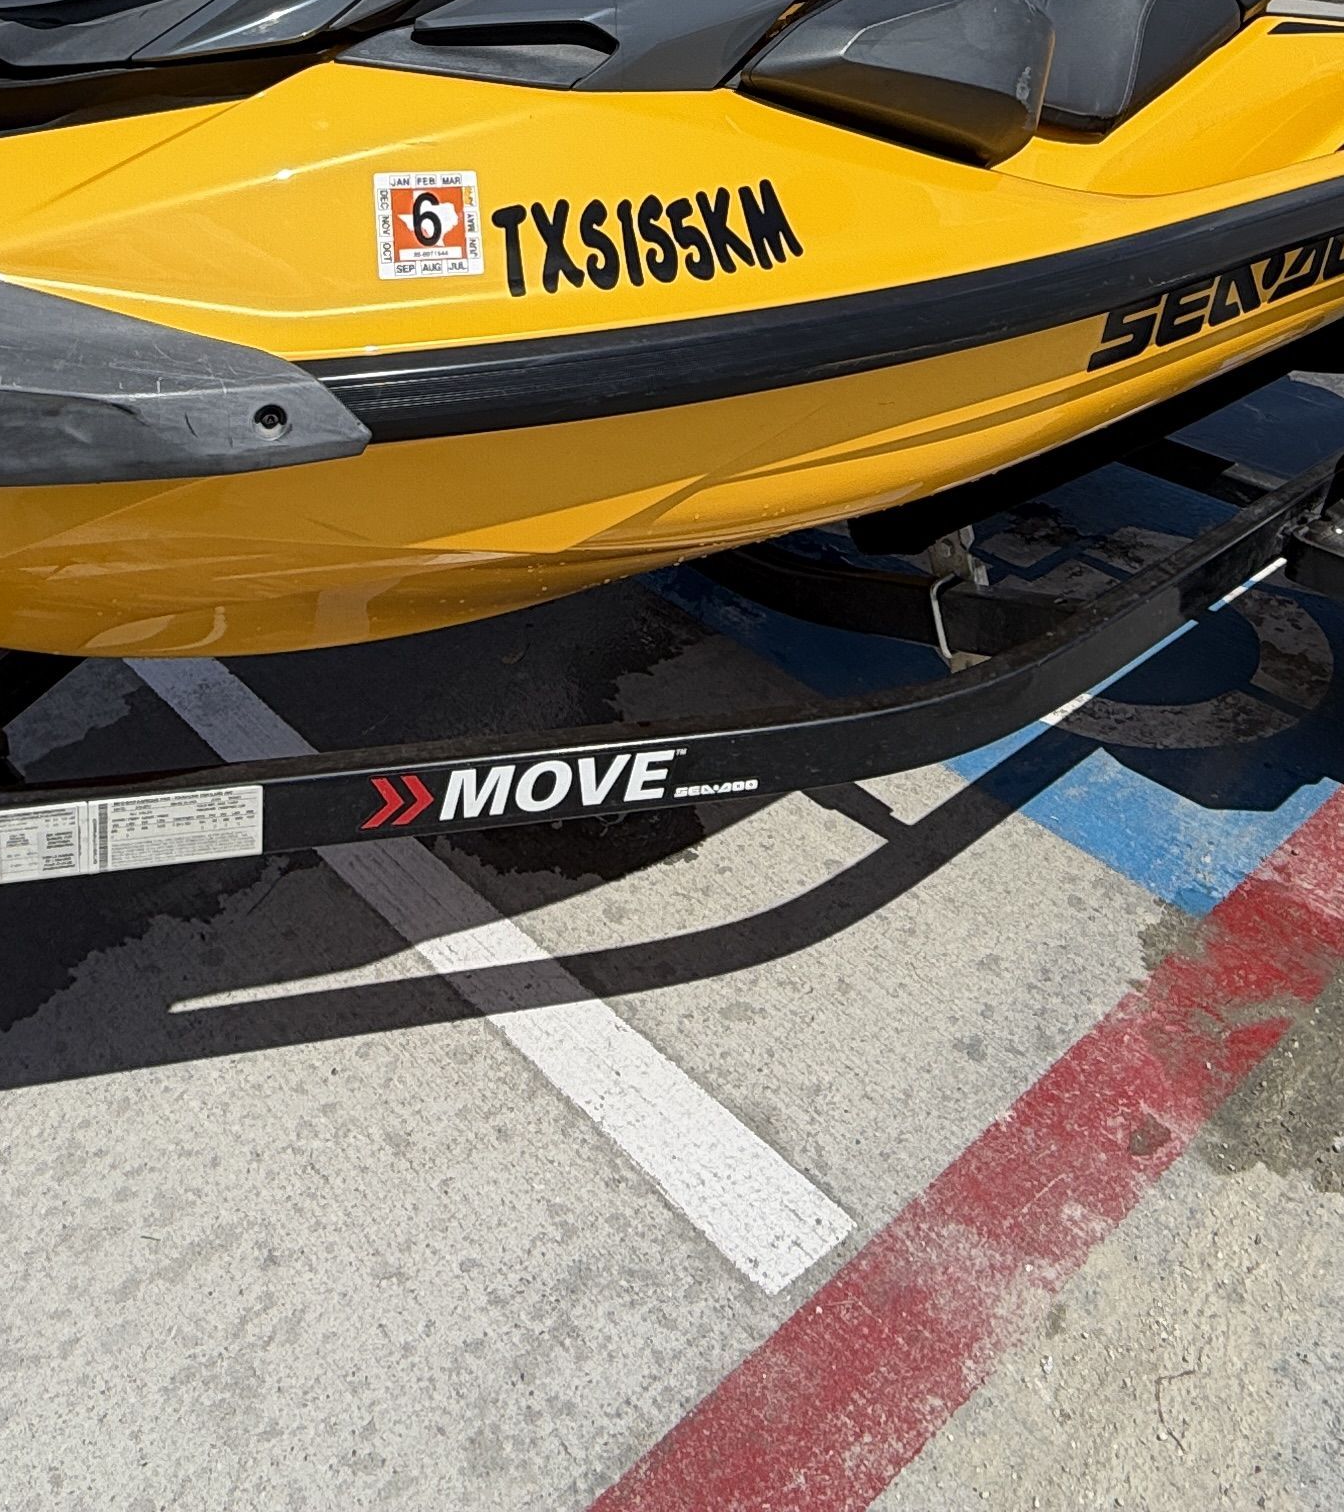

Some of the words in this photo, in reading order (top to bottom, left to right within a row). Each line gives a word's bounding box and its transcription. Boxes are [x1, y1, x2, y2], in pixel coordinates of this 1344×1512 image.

[390, 177, 410, 186] JAN
[416, 176, 436, 186] FEB
[442, 176, 461, 185] MAR
[379, 190, 389, 211] DEC
[381, 216, 391, 236] NOV
[412, 191, 442, 248] 6
[466, 213, 476, 233] MAY
[382, 242, 392, 262] OCT
[468, 238, 478, 257] JUN
[396, 264, 415, 274] SEP
[422, 262, 442, 272] AUG
[449, 261, 466, 271] JUL
[439, 749, 675, 822] MOVE
